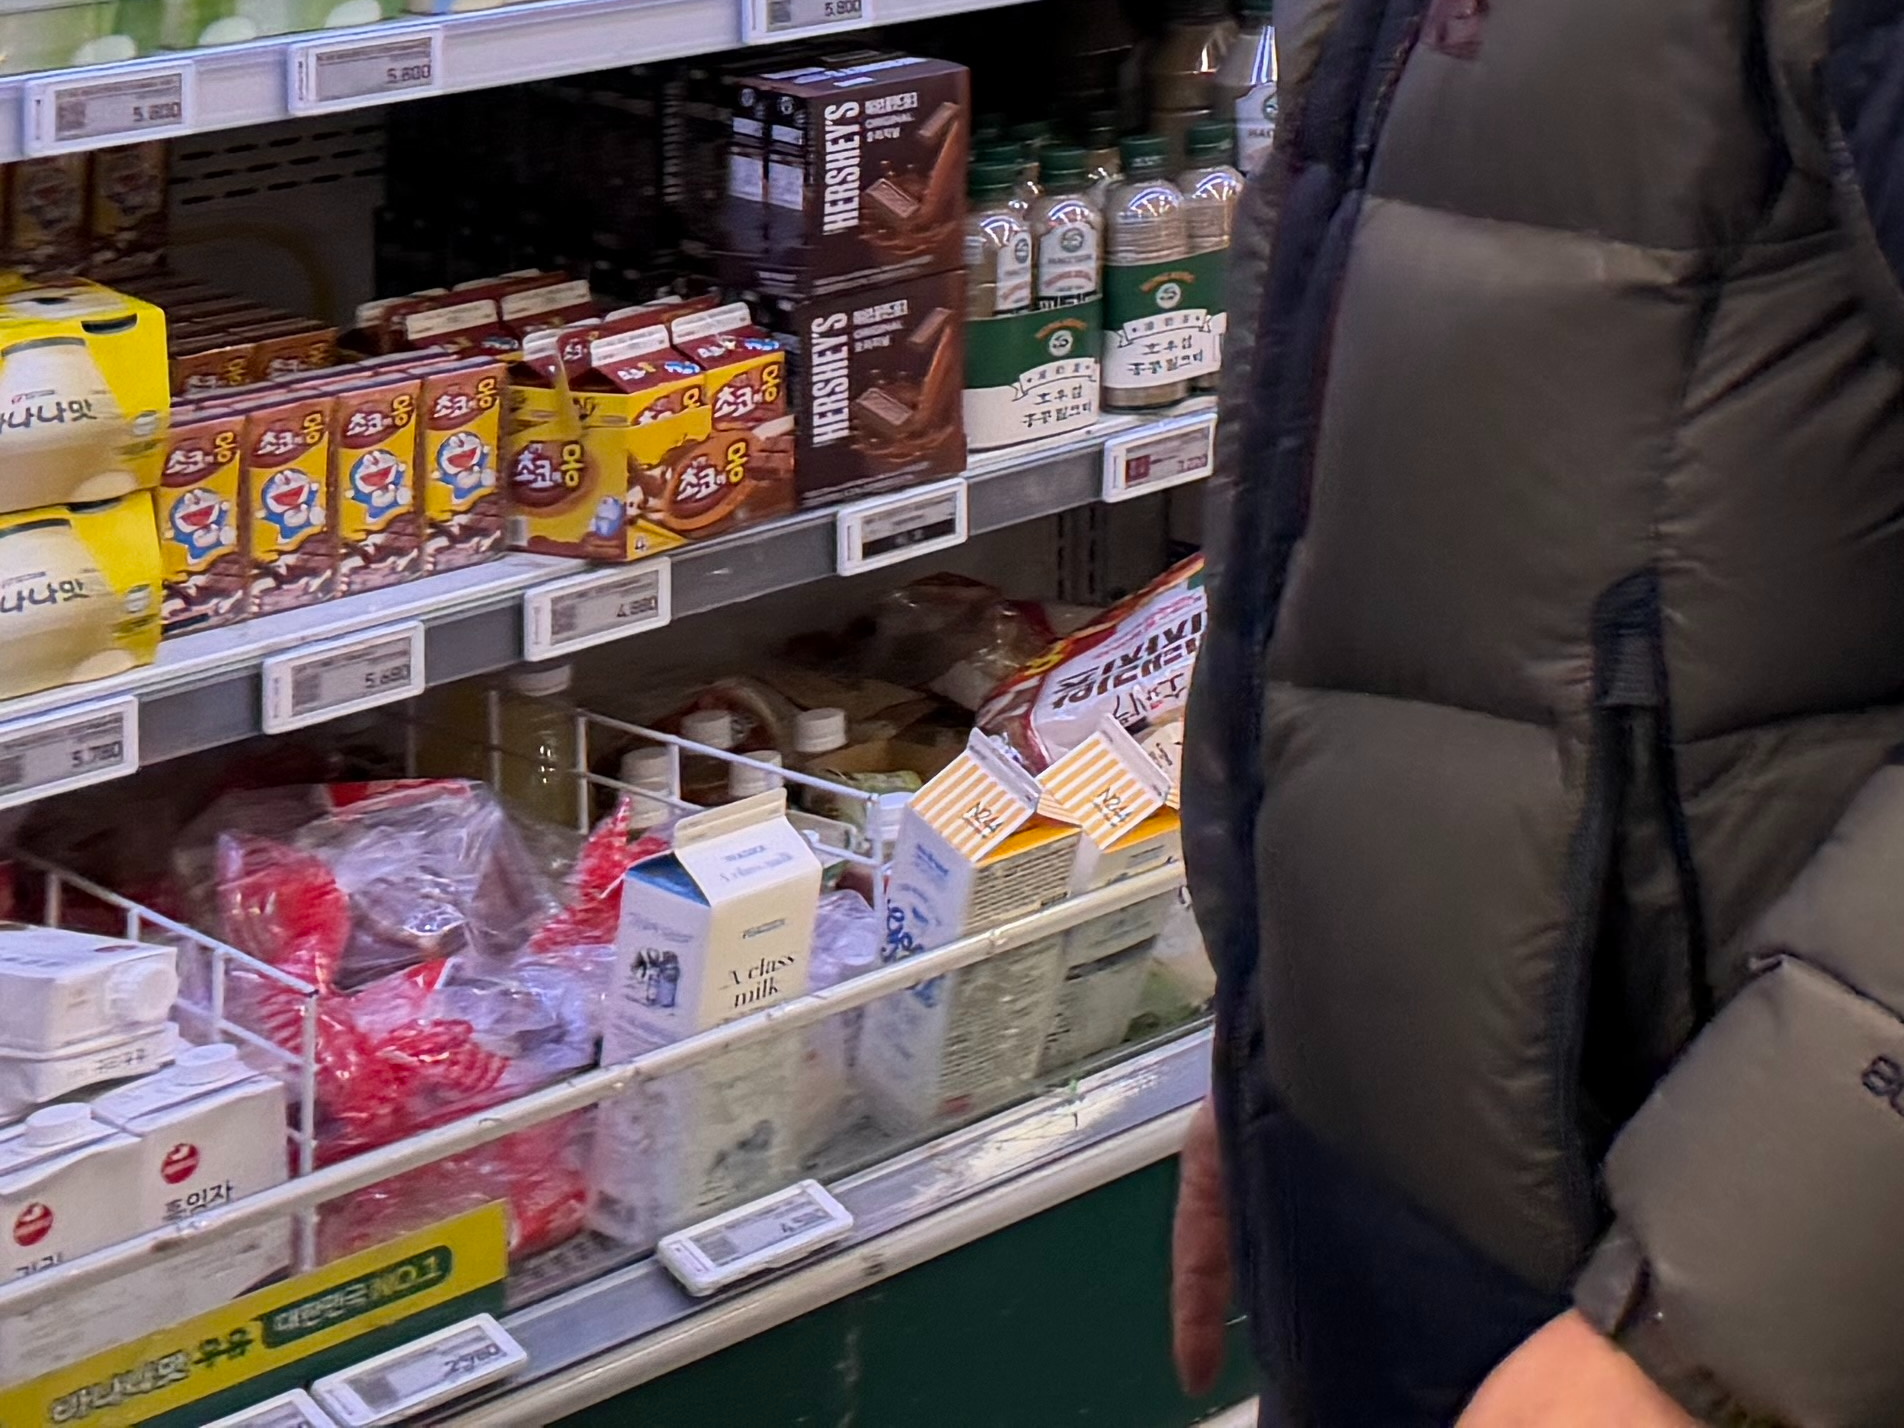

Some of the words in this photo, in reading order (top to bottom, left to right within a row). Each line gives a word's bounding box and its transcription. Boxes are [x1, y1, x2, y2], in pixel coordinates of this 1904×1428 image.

[822, 100, 861, 236] HERSHEY'S
[811, 310, 850, 448] HERSHEY'S
[733, 977, 780, 1009] milk
